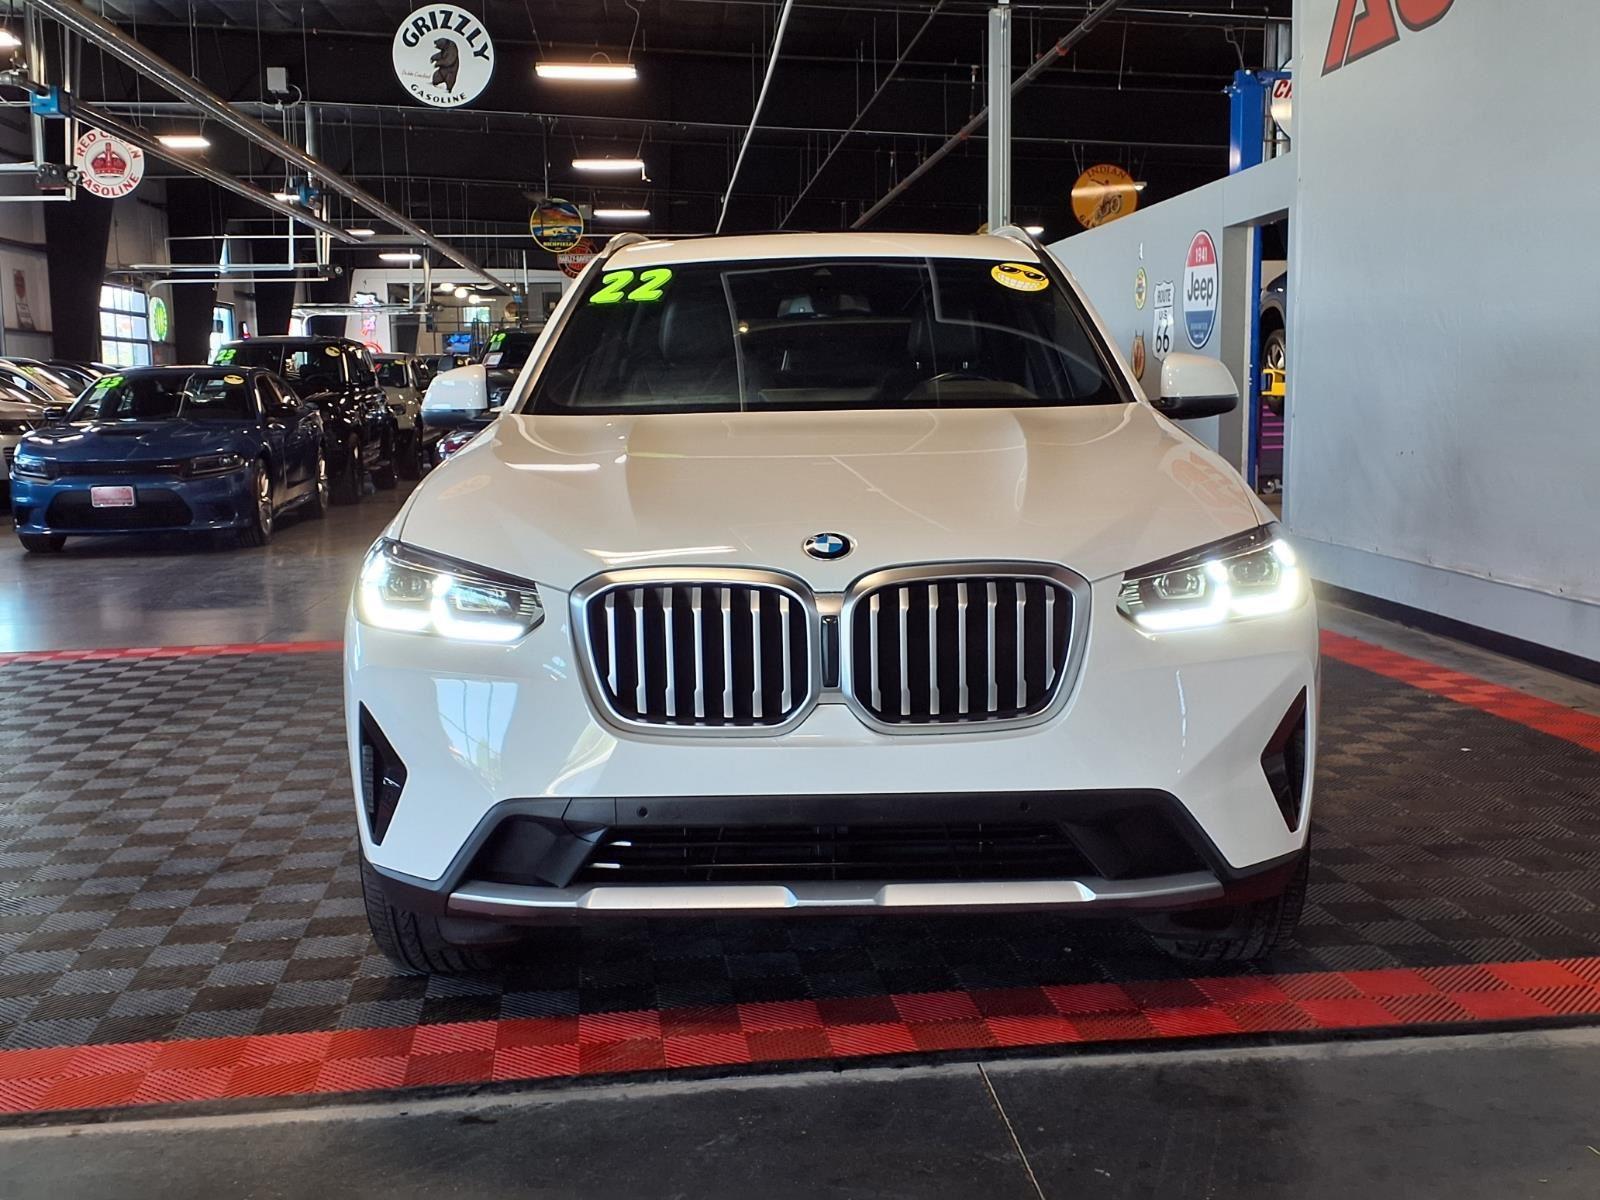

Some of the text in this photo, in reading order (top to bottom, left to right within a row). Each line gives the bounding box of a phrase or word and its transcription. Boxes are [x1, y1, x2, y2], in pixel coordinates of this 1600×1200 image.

[402, 10, 490, 61] GRIZZLY
[410, 84, 467, 104] GASOLINE
[76, 133, 97, 158] RED
[1086, 166, 1126, 179] INDIAN
[589, 268, 673, 304] 22
[1157, 288, 1172, 303] ROUTE
[1187, 272, 1214, 306] Jeep
[1155, 325, 1170, 353] 66
[216, 349, 238, 362] 23
[95, 376, 125, 390] 23
